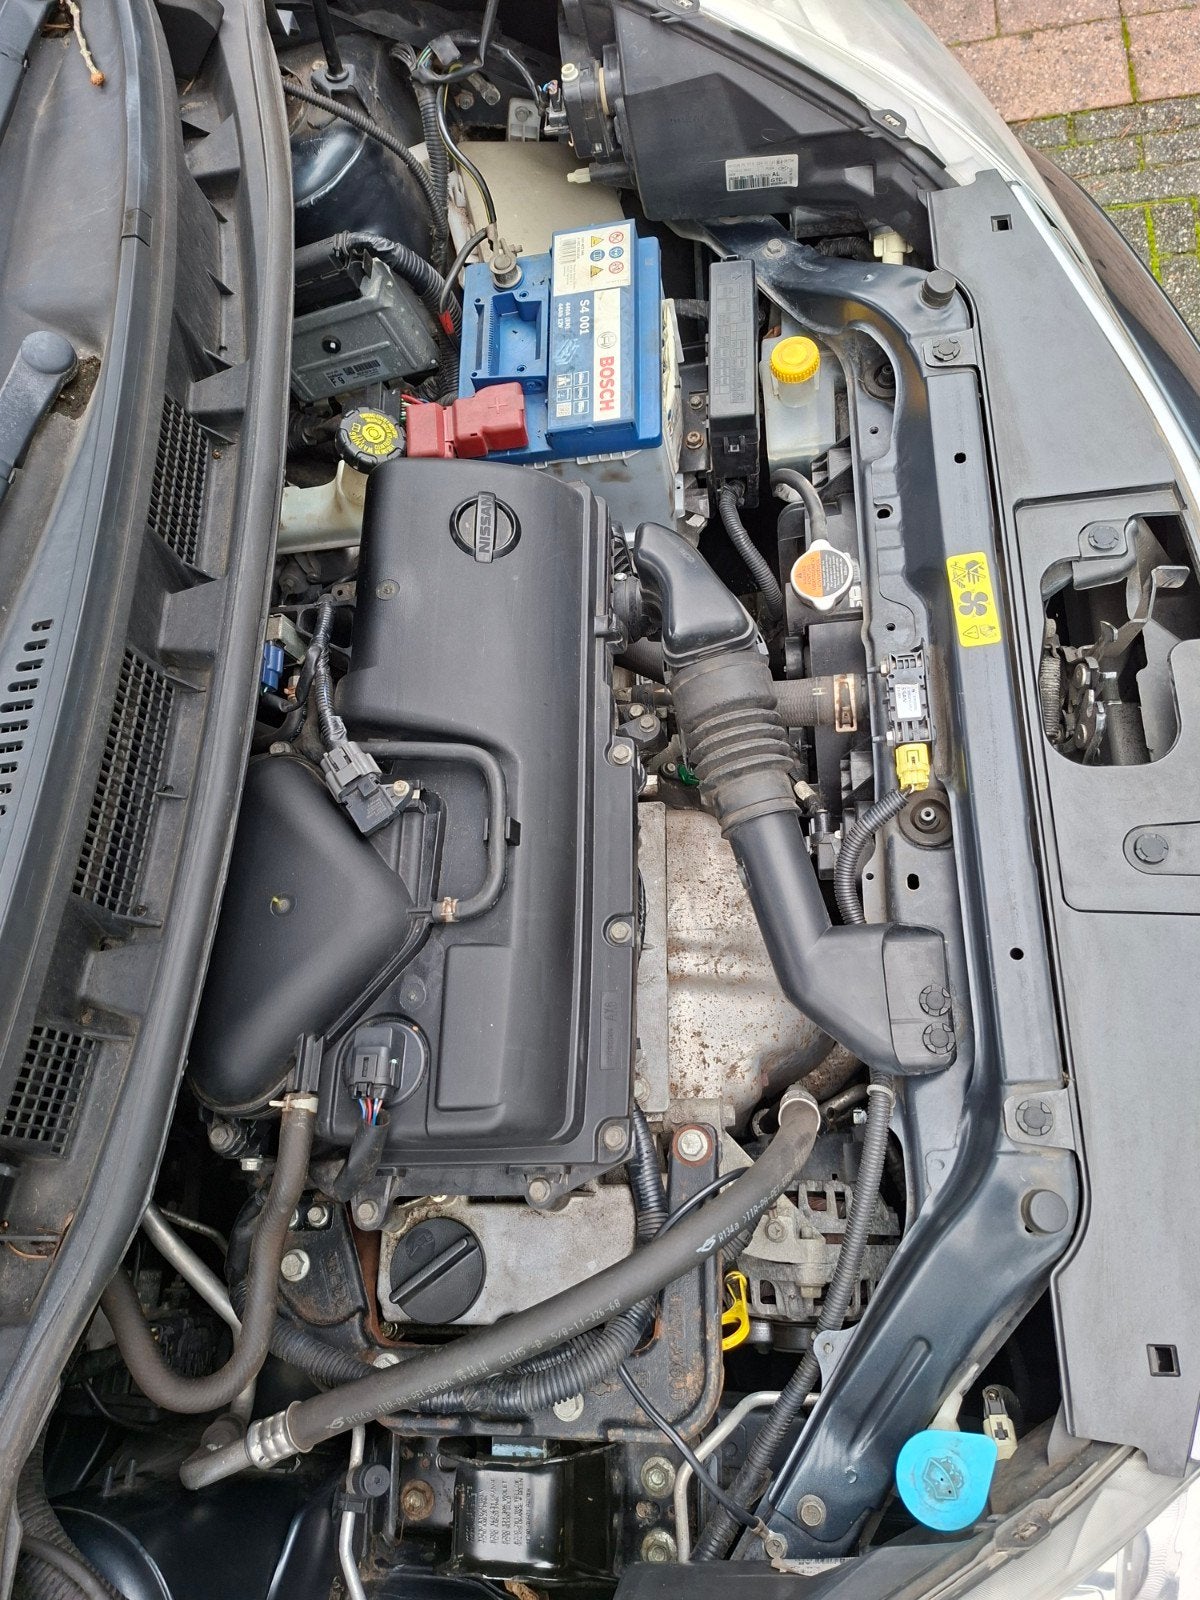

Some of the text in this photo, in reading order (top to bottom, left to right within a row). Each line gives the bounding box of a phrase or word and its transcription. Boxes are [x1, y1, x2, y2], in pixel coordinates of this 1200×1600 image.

[580, 299, 590, 336] S4 001
[599, 355, 616, 412] BOSCH
[478, 495, 494, 554] NISSAN
[718, 1222, 740, 1243] R134a
